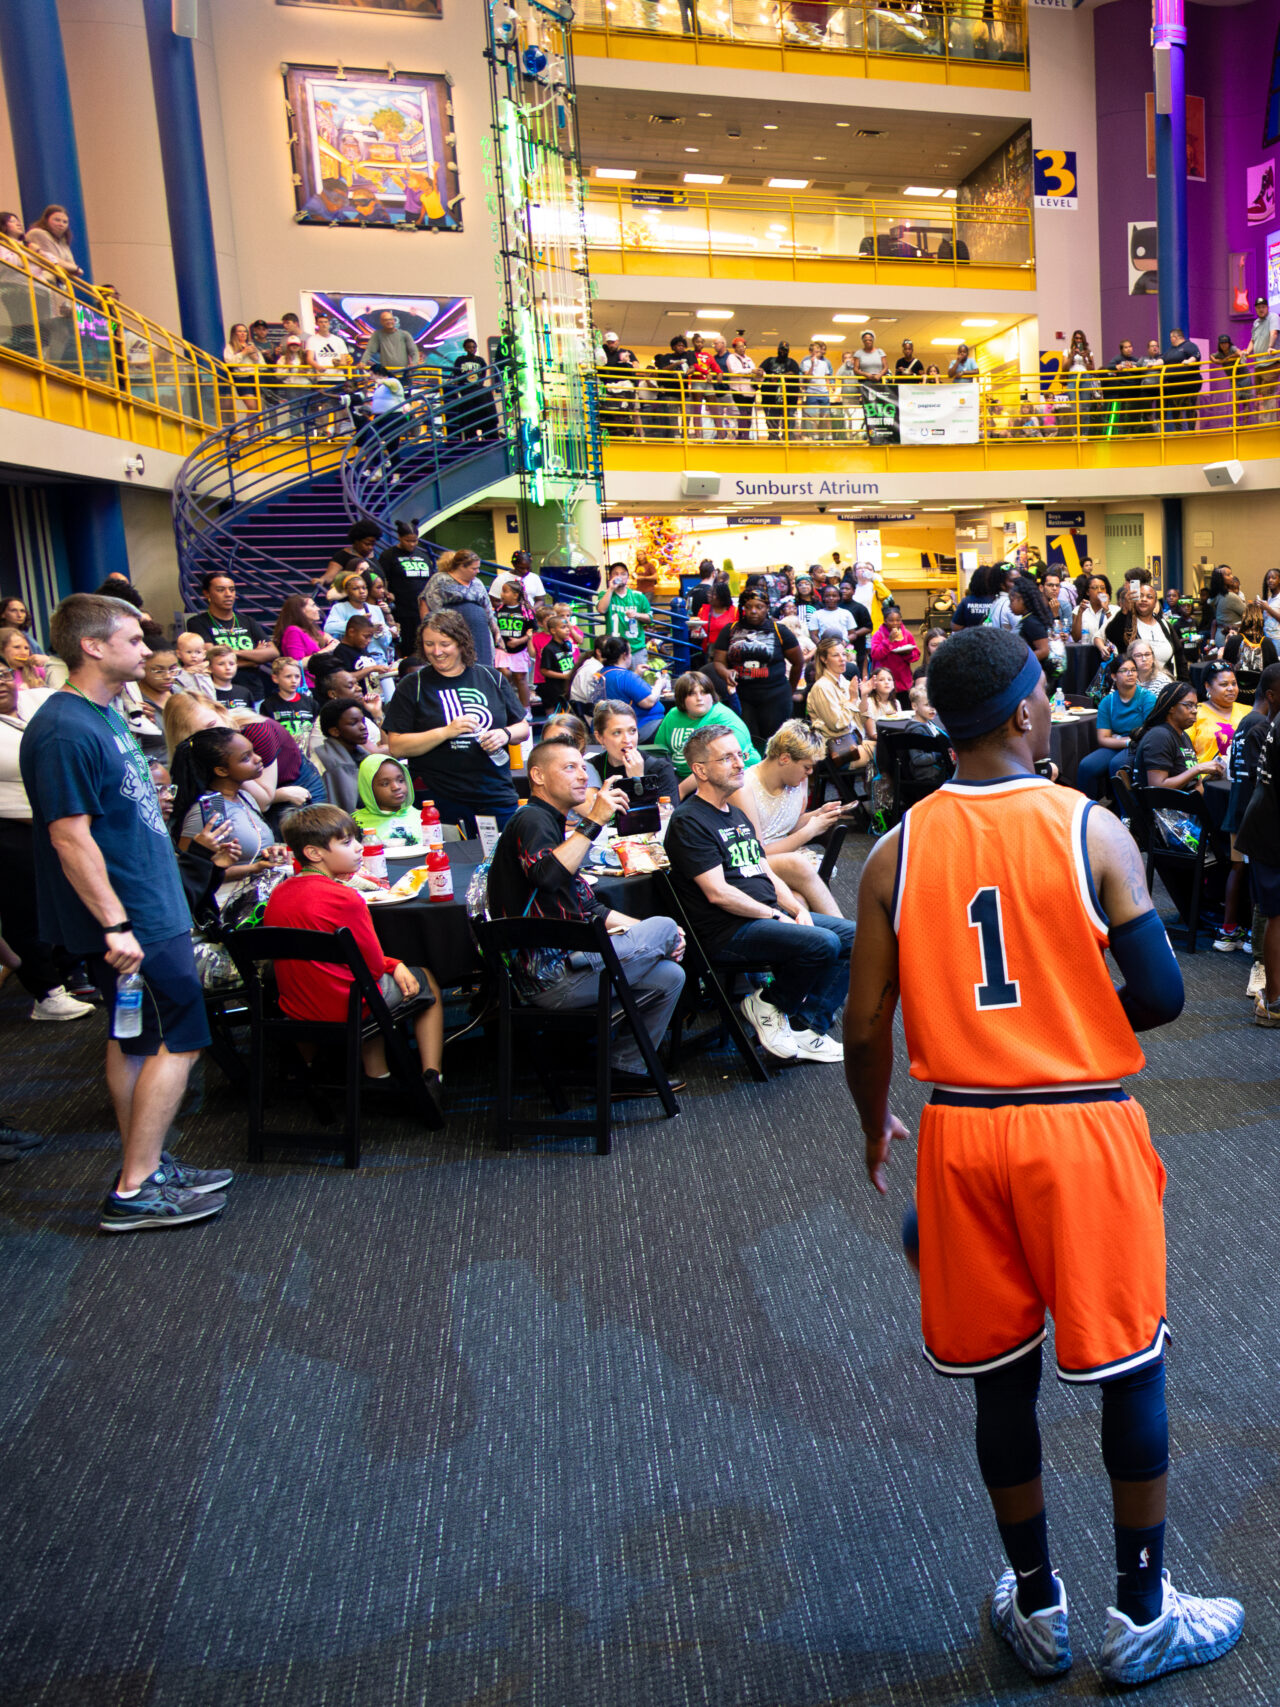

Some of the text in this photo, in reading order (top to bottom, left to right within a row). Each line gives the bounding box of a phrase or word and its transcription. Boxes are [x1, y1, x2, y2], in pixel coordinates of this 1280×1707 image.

[1035, 150, 1076, 197] 3
[1040, 198, 1072, 208] LEVEL
[500, 335, 509, 357] 5
[864, 403, 896, 418] BIG
[735, 480, 879, 496] Sunburst Atrium
[737, 517, 771, 525] Concierge
[1050, 534, 1083, 578] 1
[400, 561, 429, 570] BIG
[498, 619, 523, 631] BIG
[966, 886, 1022, 1011] 1
